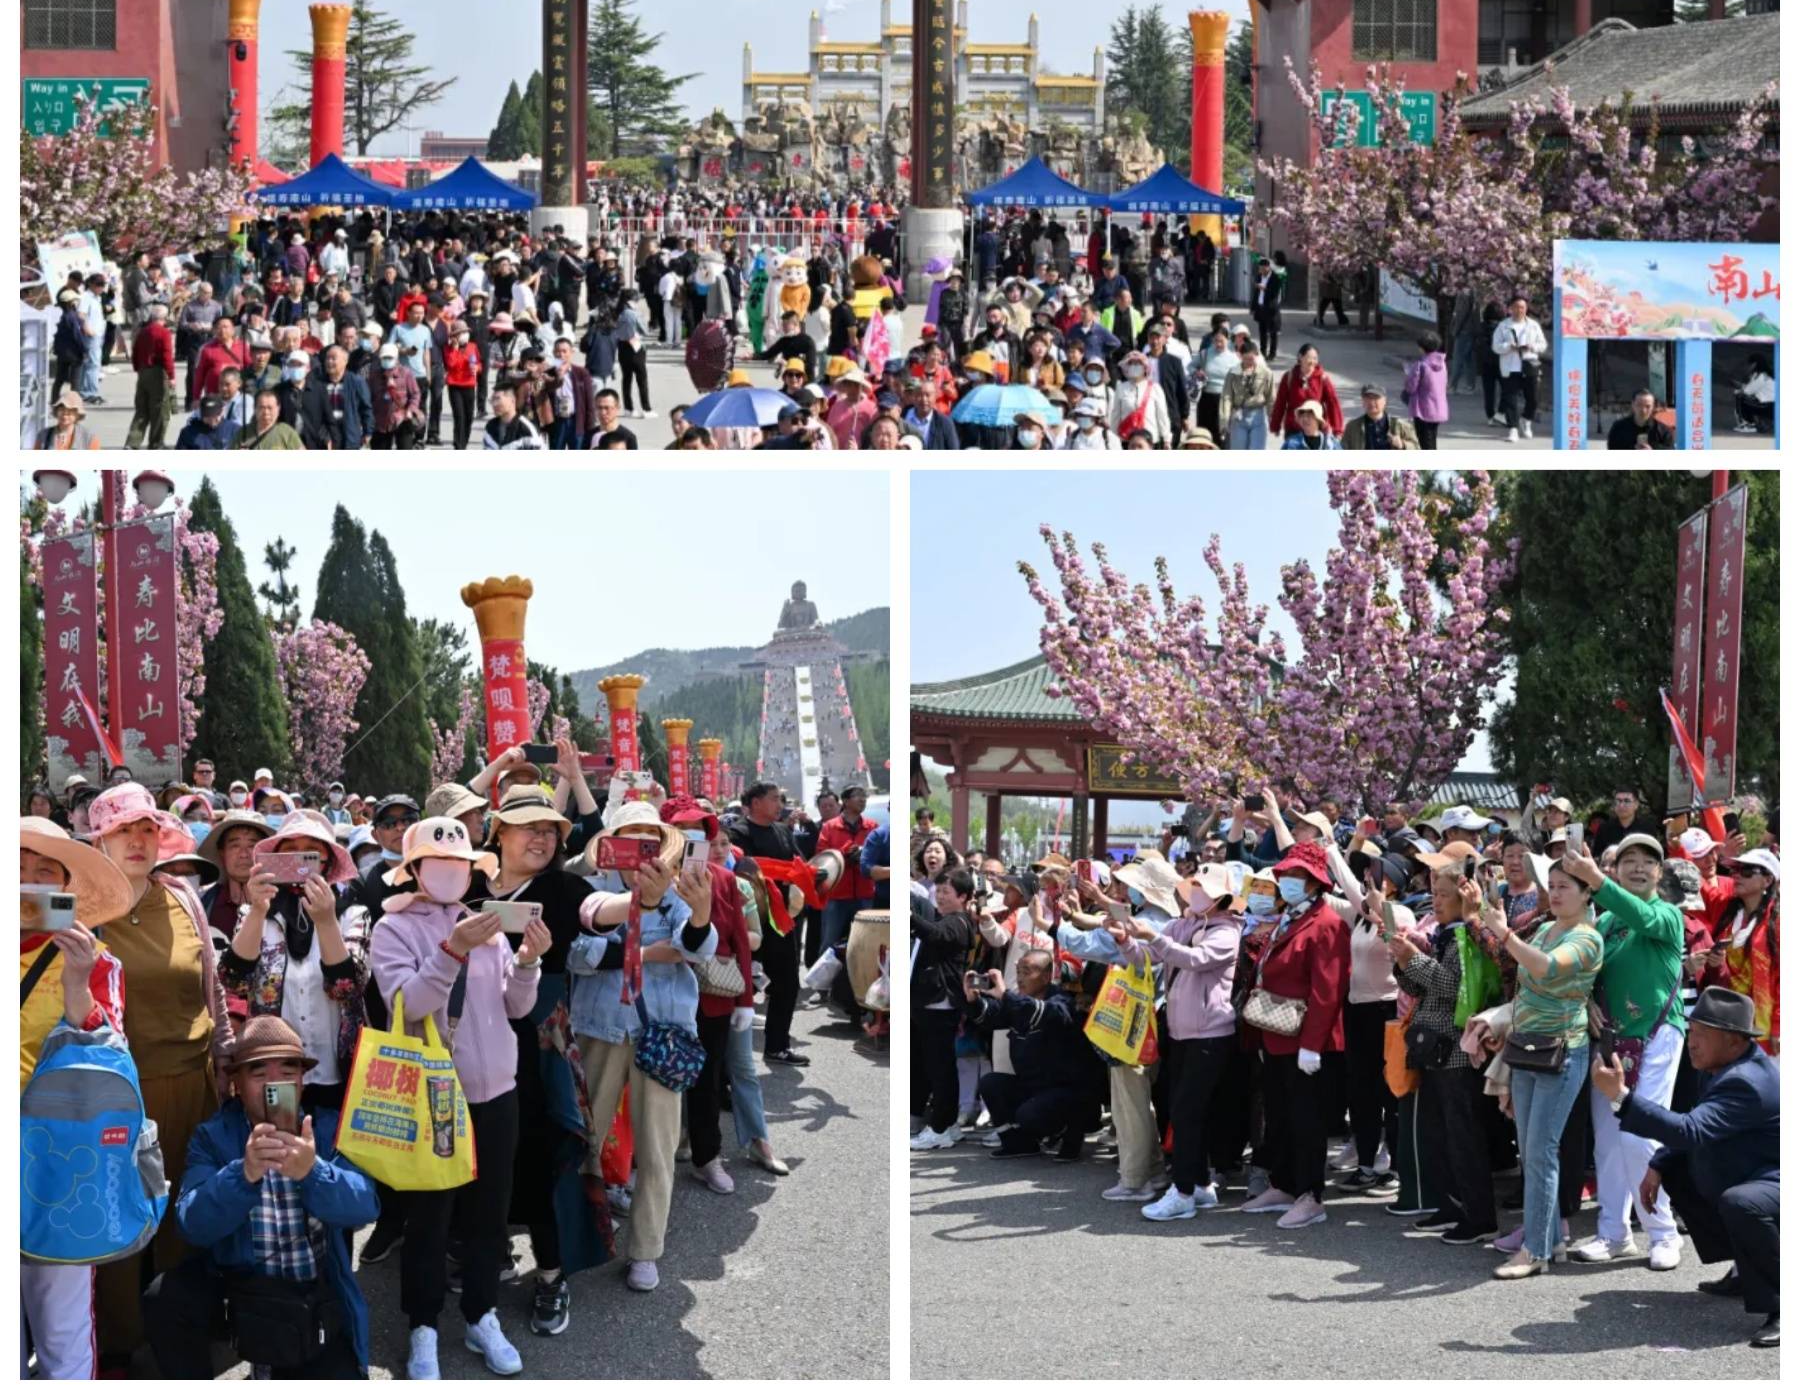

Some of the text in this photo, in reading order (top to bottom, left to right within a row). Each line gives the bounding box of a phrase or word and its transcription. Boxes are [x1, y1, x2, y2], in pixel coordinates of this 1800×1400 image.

[30, 82, 68, 95] Way in
[33, 101, 63, 114] 入り口
[1421, 96, 1430, 105] in
[1708, 254, 1780, 305] 南山
[57, 591, 86, 729] 文明在我
[134, 573, 164, 721] 寿比南山
[1713, 558, 1732, 726] 寿比南山
[365, 1057, 420, 1097] 椰树
